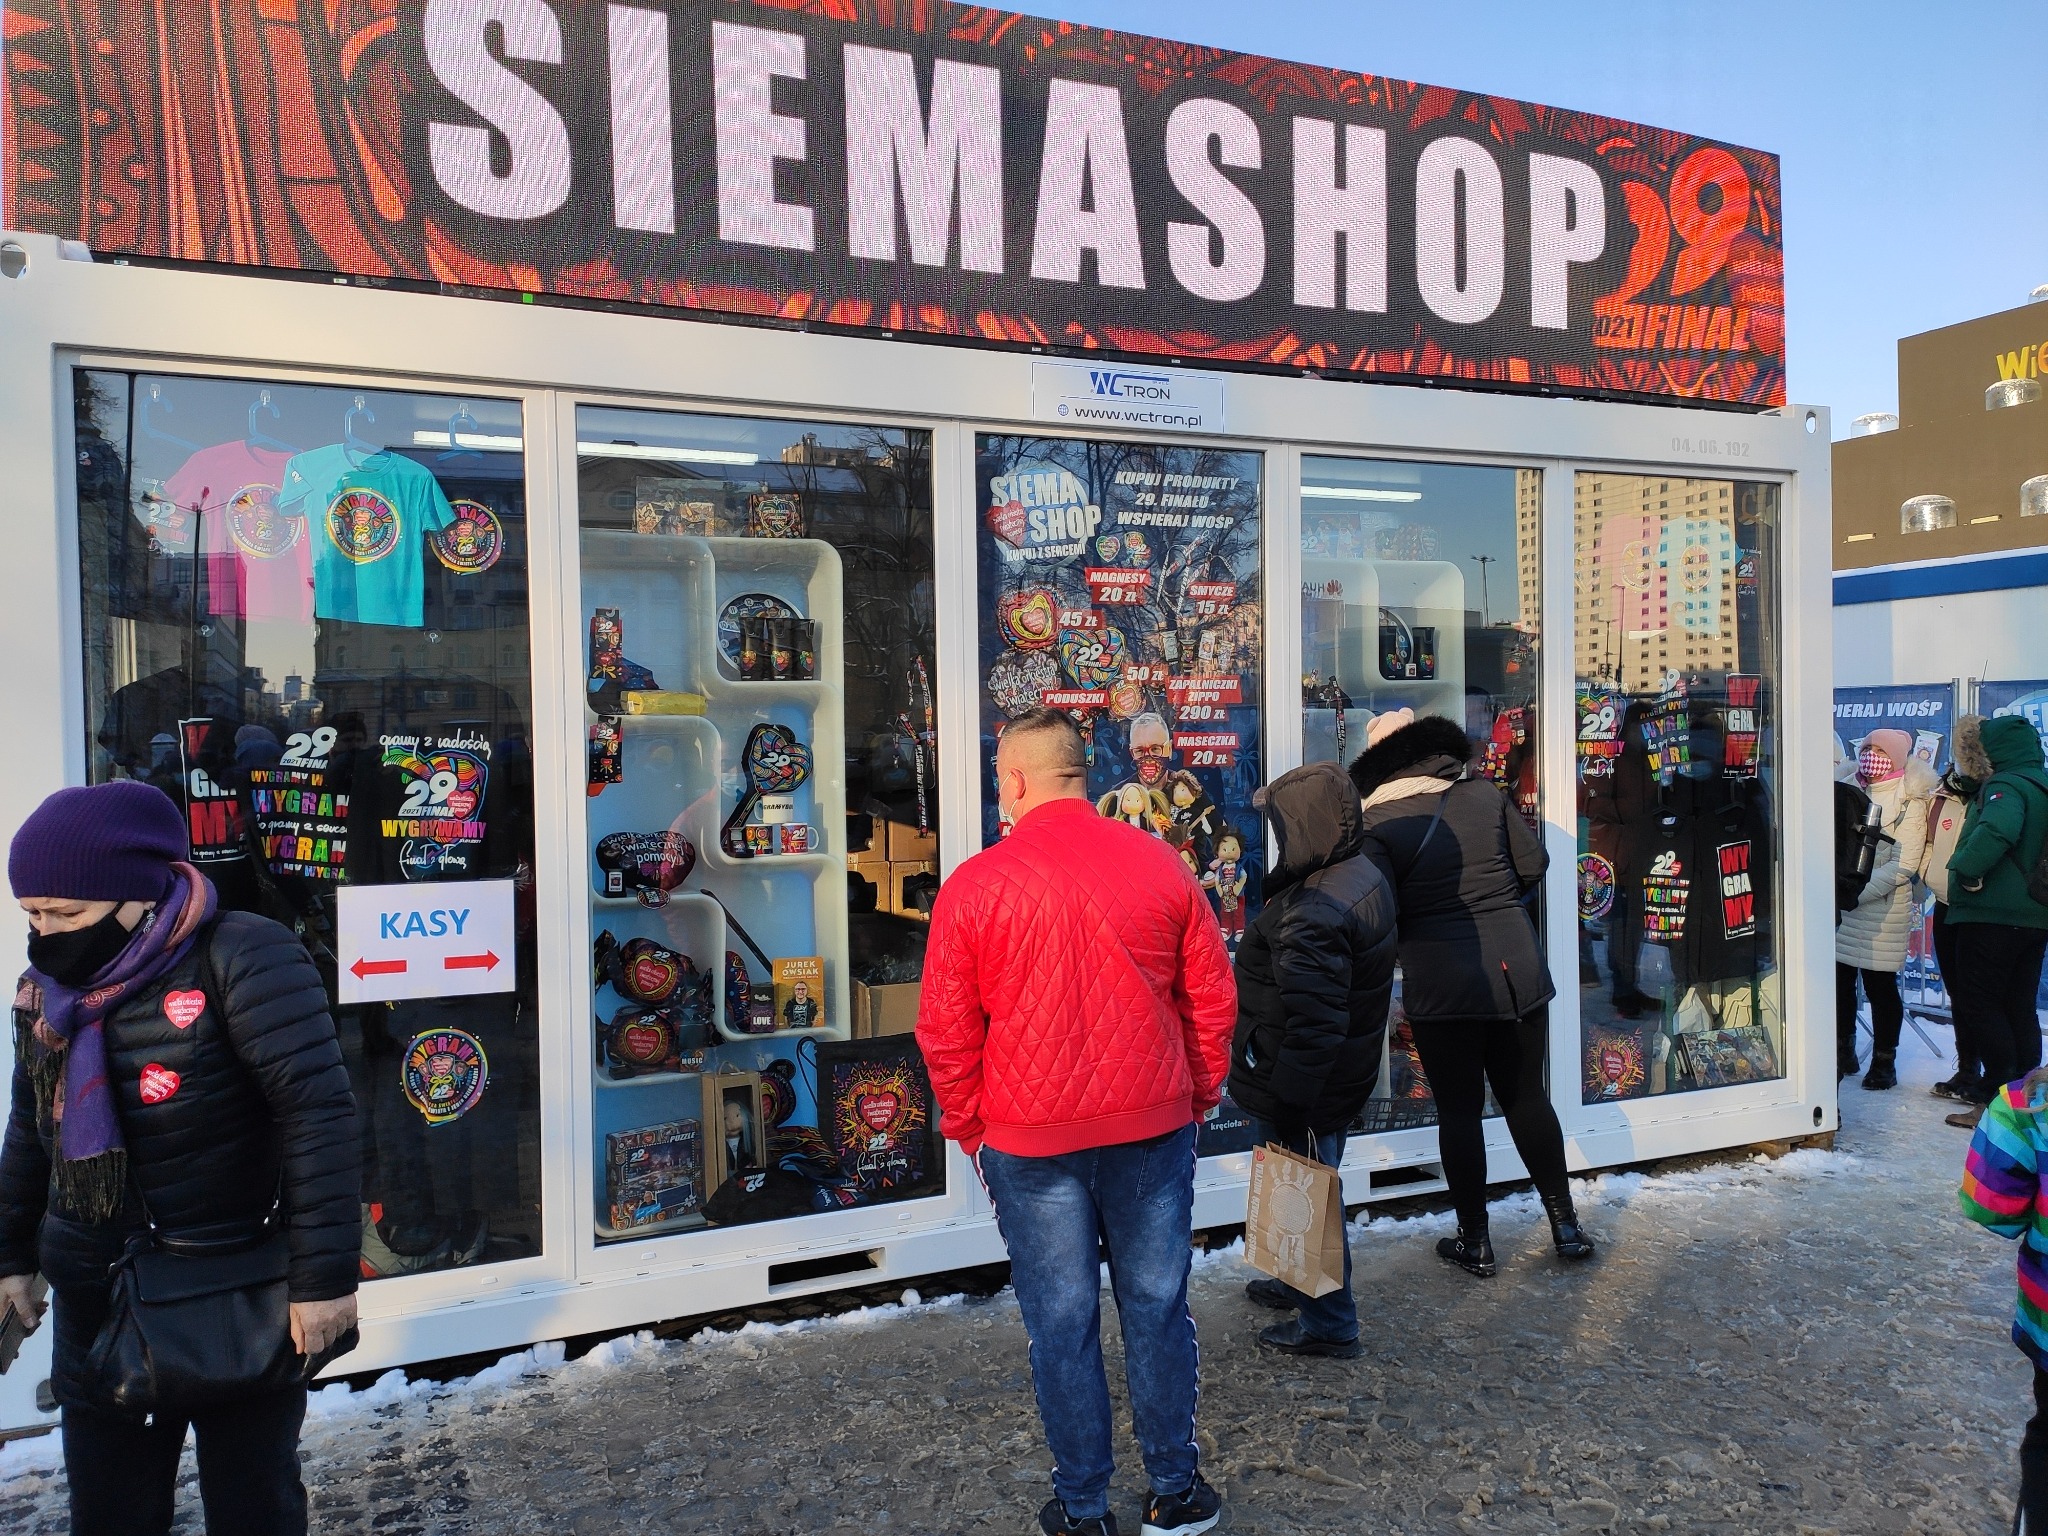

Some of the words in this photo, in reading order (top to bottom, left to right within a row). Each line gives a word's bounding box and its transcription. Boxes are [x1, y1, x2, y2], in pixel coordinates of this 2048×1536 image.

[423, 0, 1604, 330] SIEMASHOP
[1074, 407, 1202, 429] www.wctron.pl
[1114, 470, 1162, 486] KUPUJ
[1163, 474, 1239, 490] PRODUKTY
[989, 472, 1078, 508] SIEMA
[1134, 492, 1158, 506] 29.
[1160, 493, 1210, 508] FINAŁU
[1028, 504, 1102, 543] SHOP
[1117, 511, 1190, 528] WSPIERAJ
[1191, 514, 1234, 529] WOŚP
[1006, 547, 1037, 561] KUPUJ
[1037, 546, 1043, 559] Z
[1089, 571, 1147, 584] MAGNESY
[1099, 587, 1123, 602] 20
[1189, 585, 1235, 597] SMYCZE
[1197, 600, 1216, 614] 15
[1059, 611, 1083, 626] 45
[1075, 643, 1104, 664] 29
[1127, 666, 1150, 681] 50
[1168, 679, 1238, 690] ZAPALNICZKI
[1045, 692, 1105, 704] PODUSZKI
[1187, 691, 1220, 702] ZIPPO
[1179, 705, 1212, 720] 290
[1886, 699, 1943, 717] WOŚP
[1581, 706, 1616, 736] 29
[1727, 709, 1755, 732] GRA
[280, 726, 338, 764] 29
[1176, 735, 1236, 747] MASECZKA
[300, 758, 329, 770] FINA
[1191, 750, 1214, 765] 20
[251, 770, 309, 785] WYGRAMY
[400, 771, 458, 810] 29
[381, 819, 487, 839] WYGRYWAMY
[636, 852, 677, 869] pomocy
[1650, 850, 1676, 872] 29
[1720, 844, 1749, 874] WY
[1722, 872, 1752, 897] GRA
[1724, 893, 1754, 928] MY
[380, 908, 471, 939] KASY
[782, 968, 819, 976] OWSIAK
[785, 960, 816, 969] JUREK
[752, 1016, 771, 1025] LOVE
[409, 1036, 479, 1068] WYGRAMY
[670, 1132, 696, 1143] PUZZLE
[867, 1132, 888, 1151] 29
